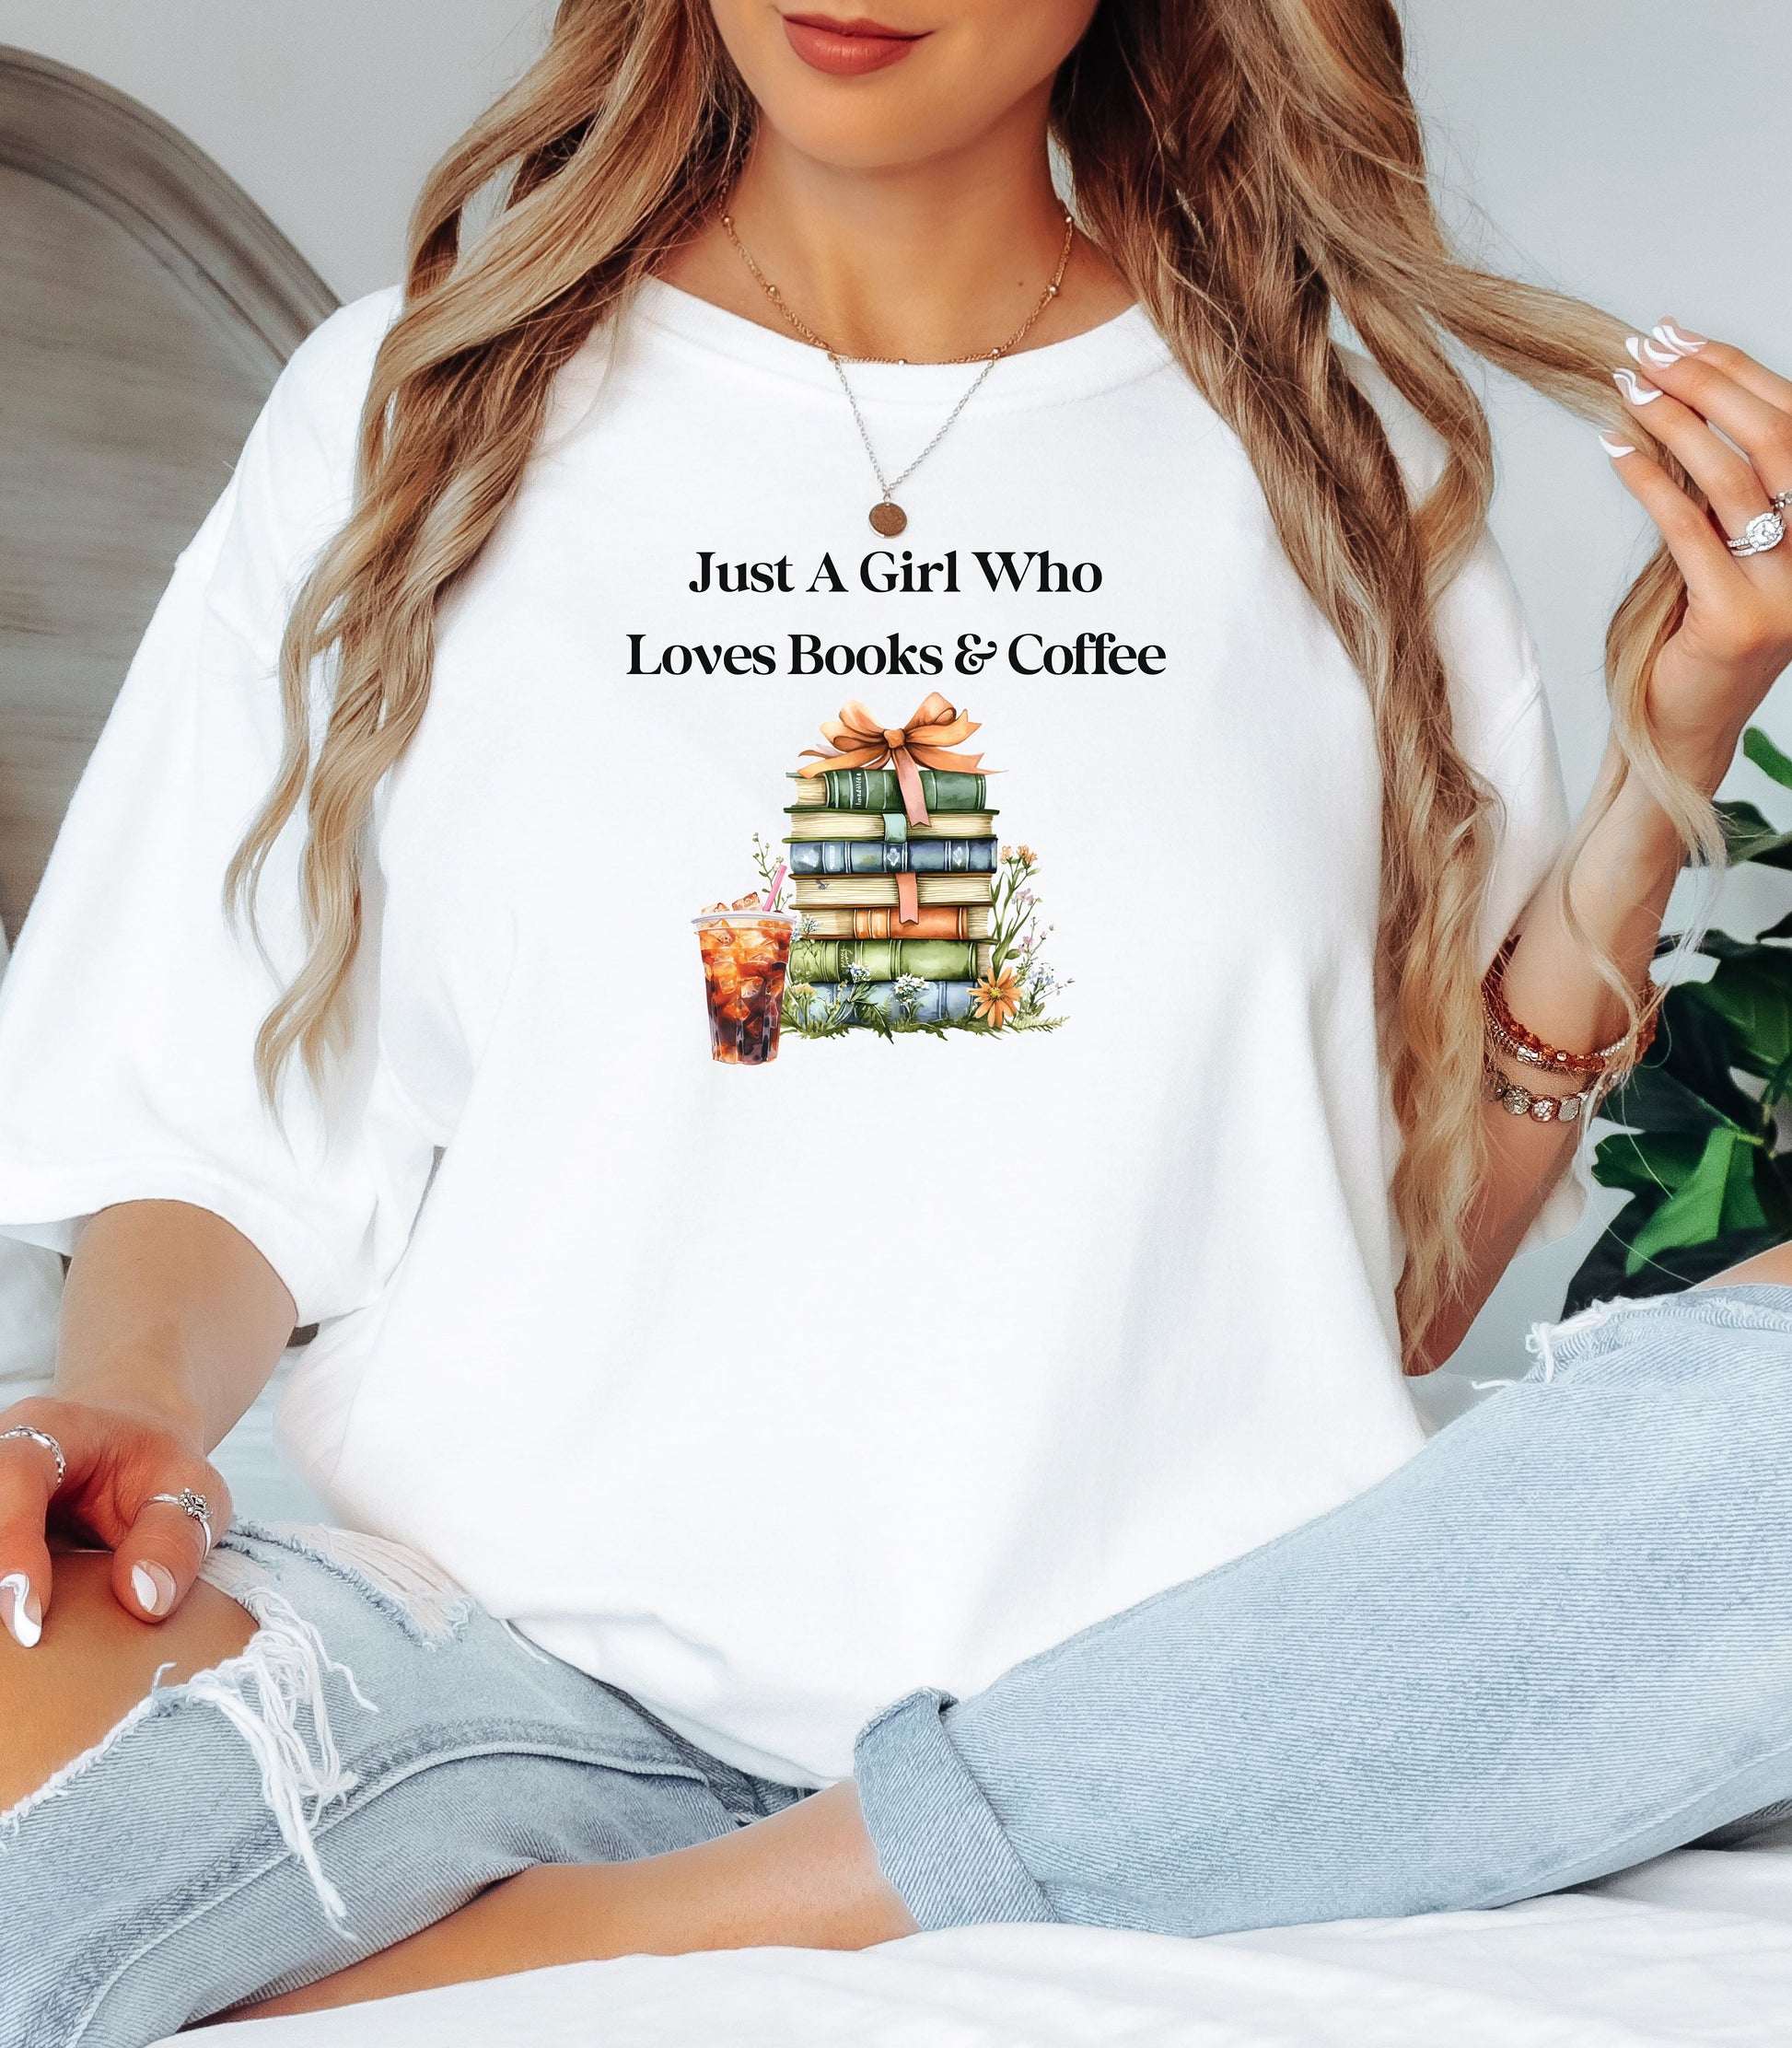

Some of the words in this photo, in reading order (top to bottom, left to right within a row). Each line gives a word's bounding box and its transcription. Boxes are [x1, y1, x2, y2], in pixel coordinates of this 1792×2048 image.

[688, 552, 796, 593] Just
[805, 552, 849, 593] A
[859, 550, 961, 593] Girl
[971, 550, 1103, 593] Who
[625, 634, 776, 676] Loves
[786, 632, 944, 676] Books
[954, 633, 998, 676] &
[1007, 632, 1167, 676] Coffee
